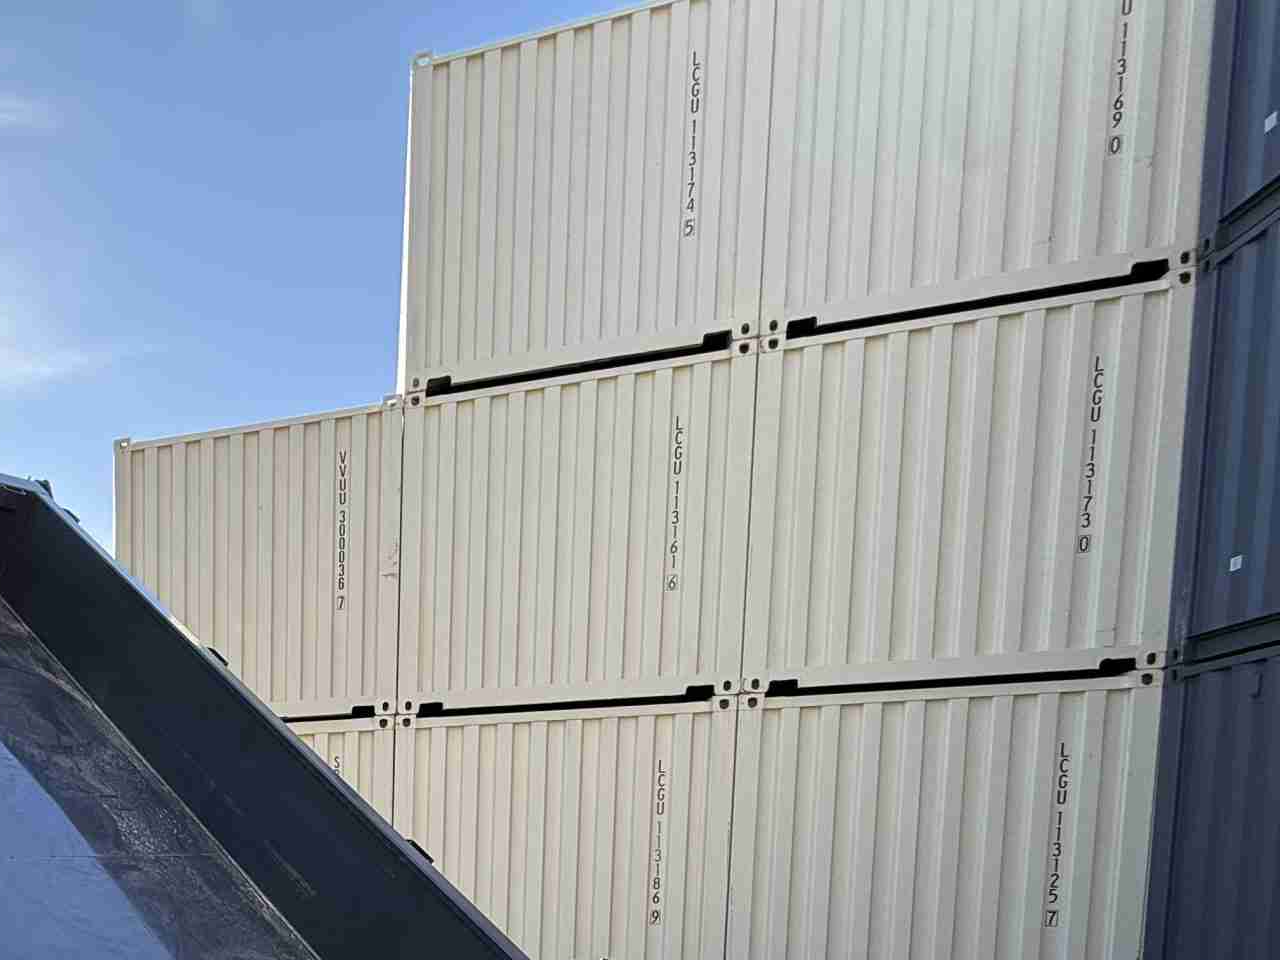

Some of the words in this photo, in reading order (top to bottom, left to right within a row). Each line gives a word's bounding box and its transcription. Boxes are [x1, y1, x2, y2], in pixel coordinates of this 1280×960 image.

[690, 51, 701, 114] LCGU
[1112, 22, 1128, 129] 113169
[686, 119, 697, 213] 113174
[1110, 136, 1121, 155] 0
[684, 219, 695, 237] 5
[1090, 356, 1104, 423] LCGU
[673, 415, 684, 475] LCGU
[338, 450, 347, 505] VVUU
[1081, 428, 1097, 528] 113173
[337, 510, 346, 591] 300036
[669, 480, 680, 569] 113161
[1079, 535, 1090, 552] 0
[336, 595, 345, 610] 7
[667, 575, 677, 591] 6
[656, 759, 665, 816] LCGU
[1056, 742, 1070, 805] LCGU
[652, 820, 662, 905] 113186
[1047, 811, 1063, 904] 113125
[651, 909, 660, 925] 9
[1046, 910, 1057, 926] 7
